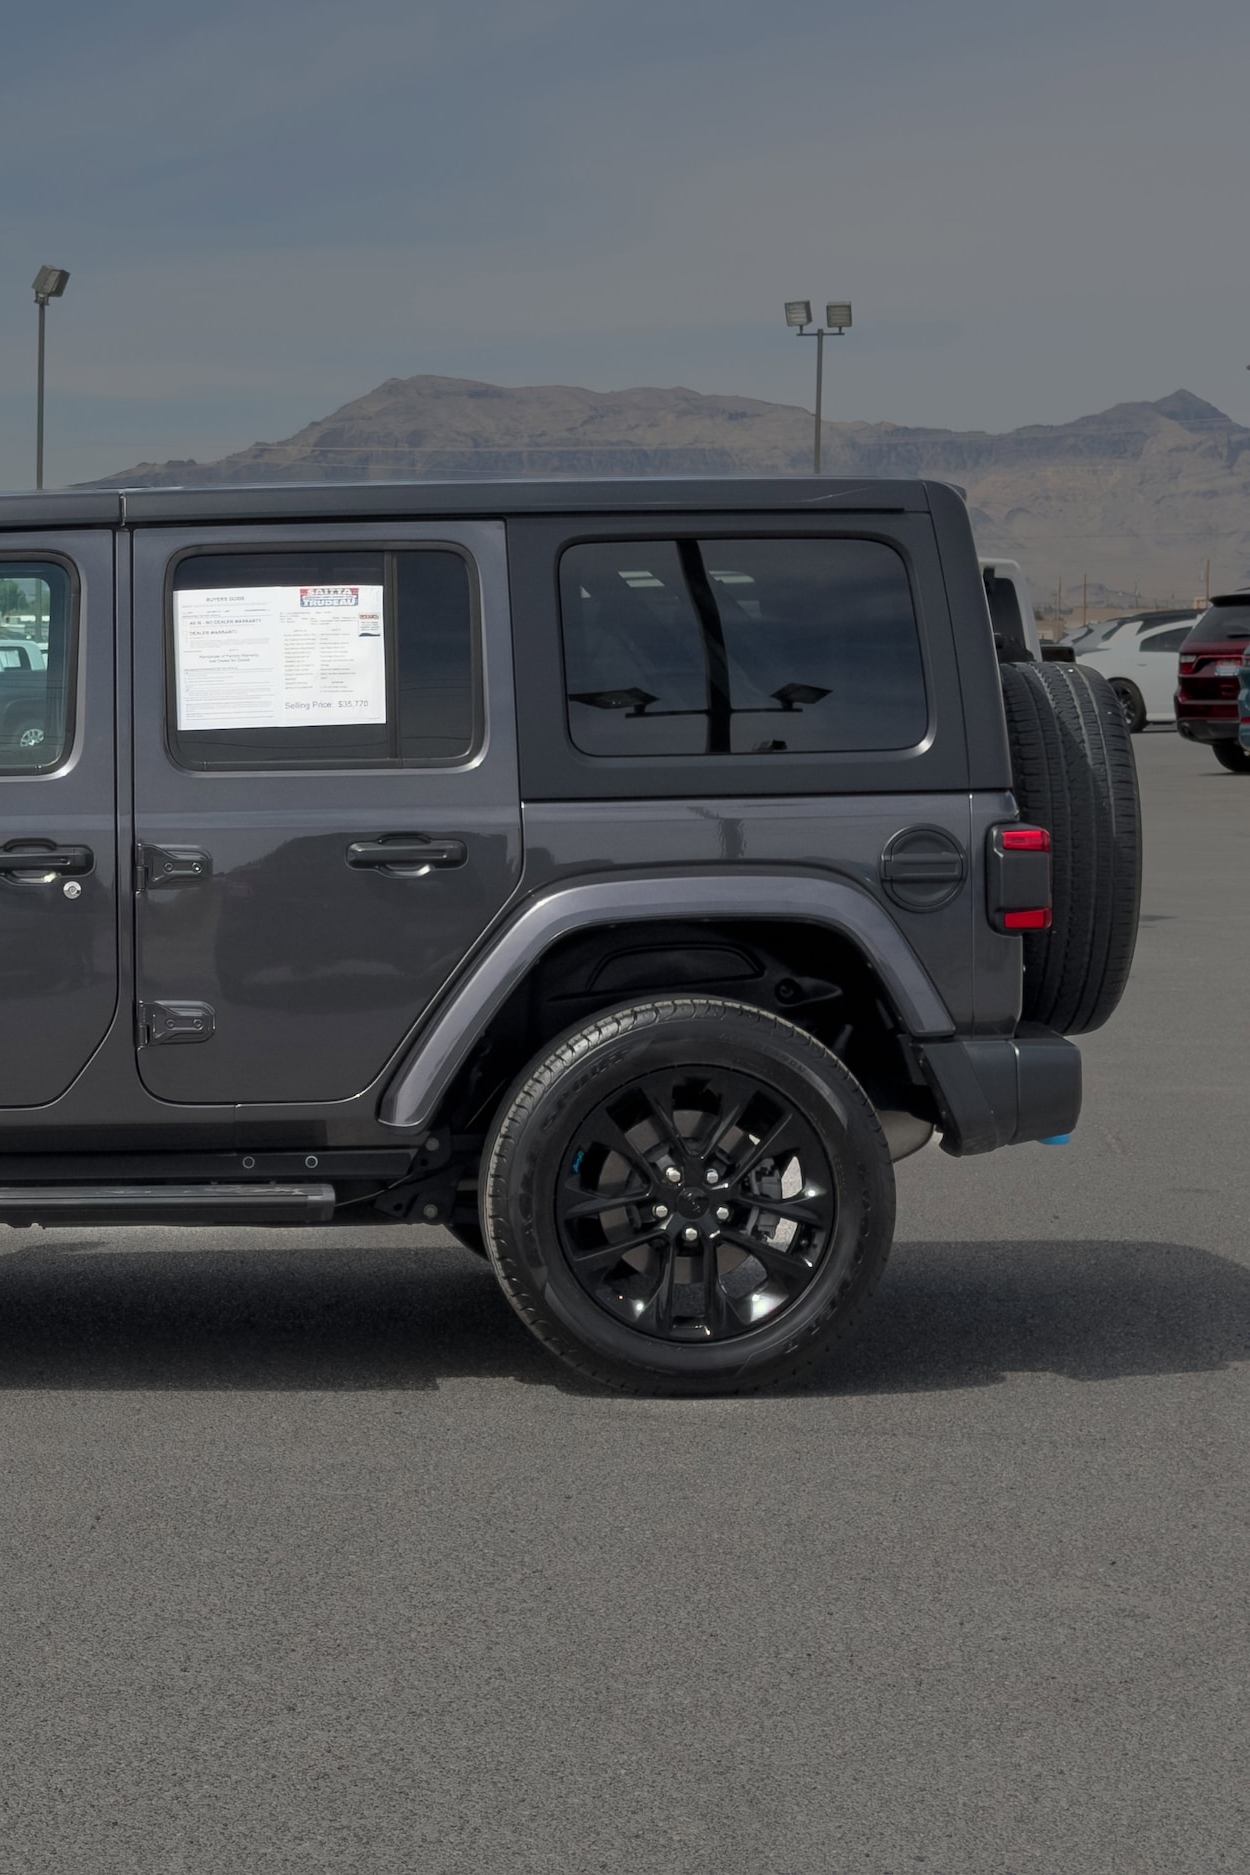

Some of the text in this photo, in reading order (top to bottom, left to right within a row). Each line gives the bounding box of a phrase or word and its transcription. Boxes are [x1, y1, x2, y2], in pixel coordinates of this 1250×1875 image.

[307, 588, 352, 596] SAITTA
[301, 597, 356, 606] TRUDEAU
[285, 702, 310, 710] Selling
[338, 700, 369, 708] $35,770
